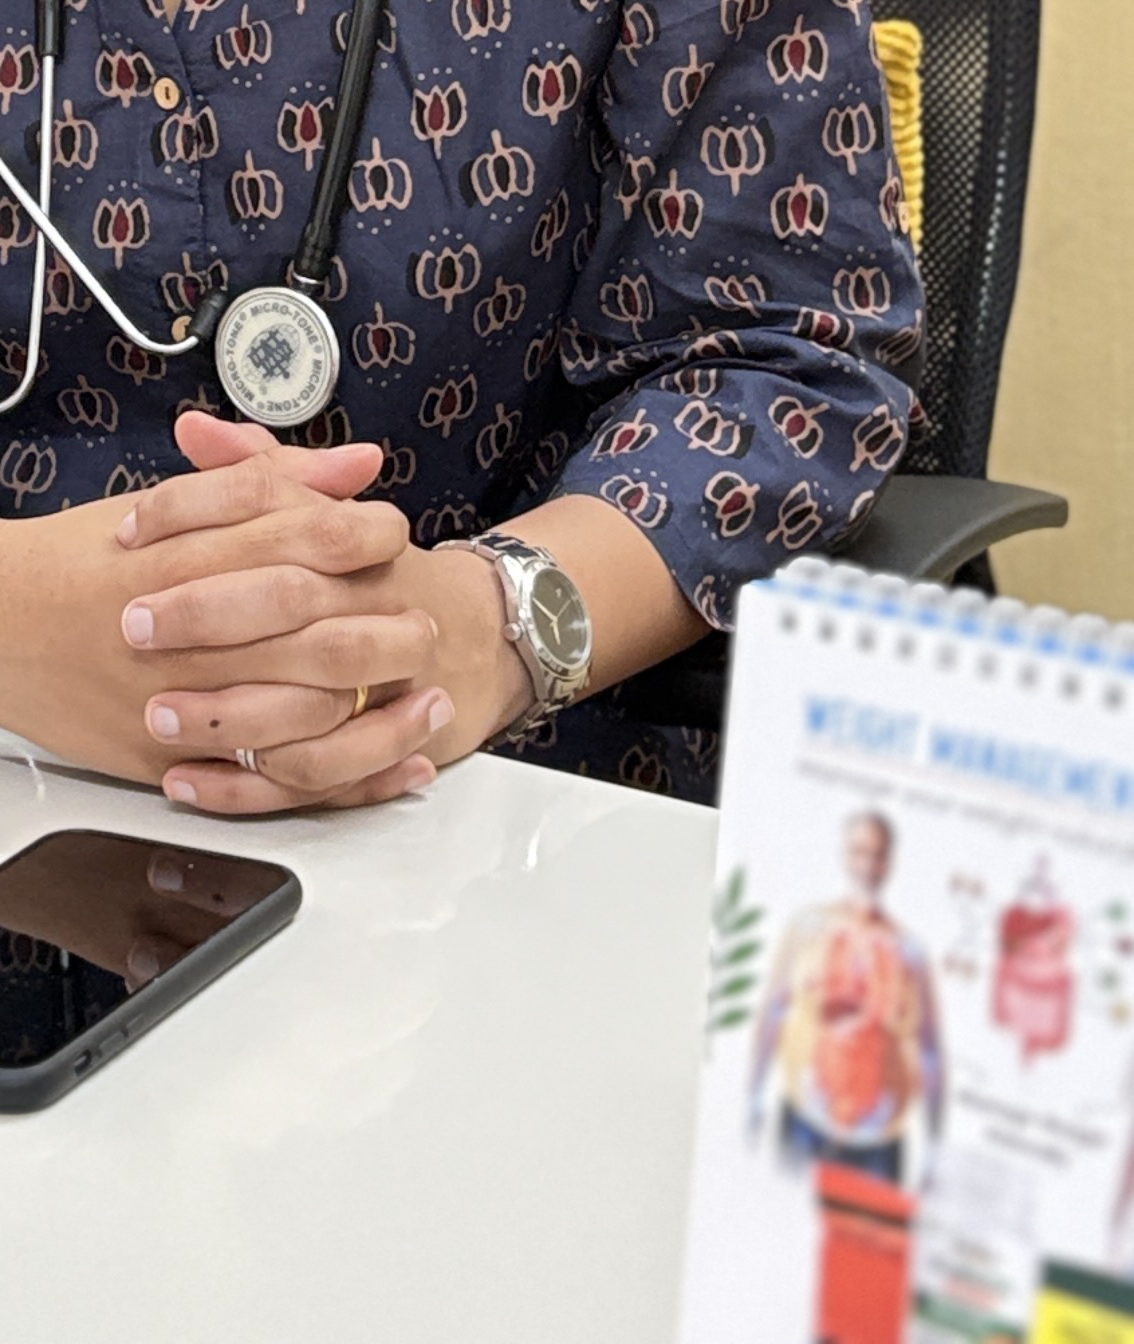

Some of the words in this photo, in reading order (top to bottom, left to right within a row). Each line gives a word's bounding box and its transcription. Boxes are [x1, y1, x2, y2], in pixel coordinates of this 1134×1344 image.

[250, 302, 319, 345] MICRO-TONE
[226, 319, 256, 403] MICRO-TONE
[266, 359, 323, 412] MICRO-TONE
[805, 694, 920, 758] WEIGHT
